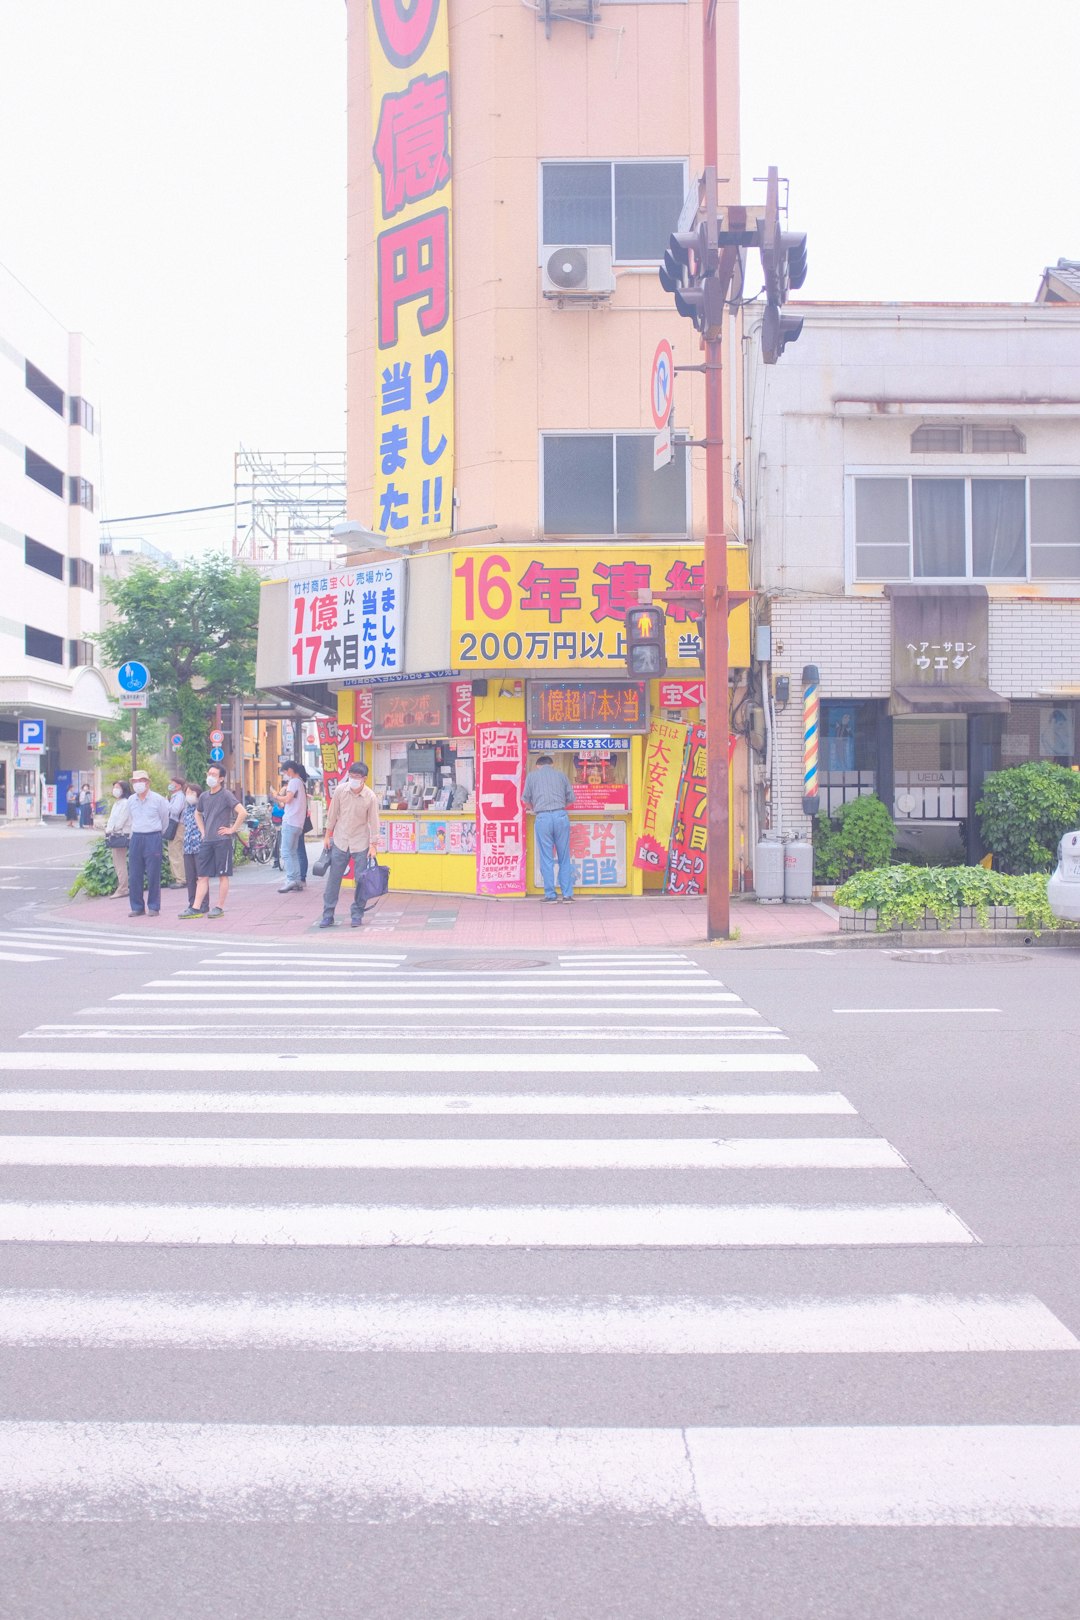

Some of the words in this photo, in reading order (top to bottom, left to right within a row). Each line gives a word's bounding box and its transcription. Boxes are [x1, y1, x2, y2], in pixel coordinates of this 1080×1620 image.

[294, 568, 393, 595] 竹村商店宝くじ売場から
[907, 642, 977, 652] ヘアーサロン
[360, 692, 373, 739] 宝くじ
[456, 685, 472, 735] 宝くじ
[23, 723, 40, 743] P
[482, 730, 519, 744] ドリーム
[482, 745, 519, 759] ジャンボ
[644, 739, 671, 830] 大安吉日
[918, 772, 945, 782] UEDA
[482, 761, 520, 821] 5
[483, 822, 519, 843] 億円
